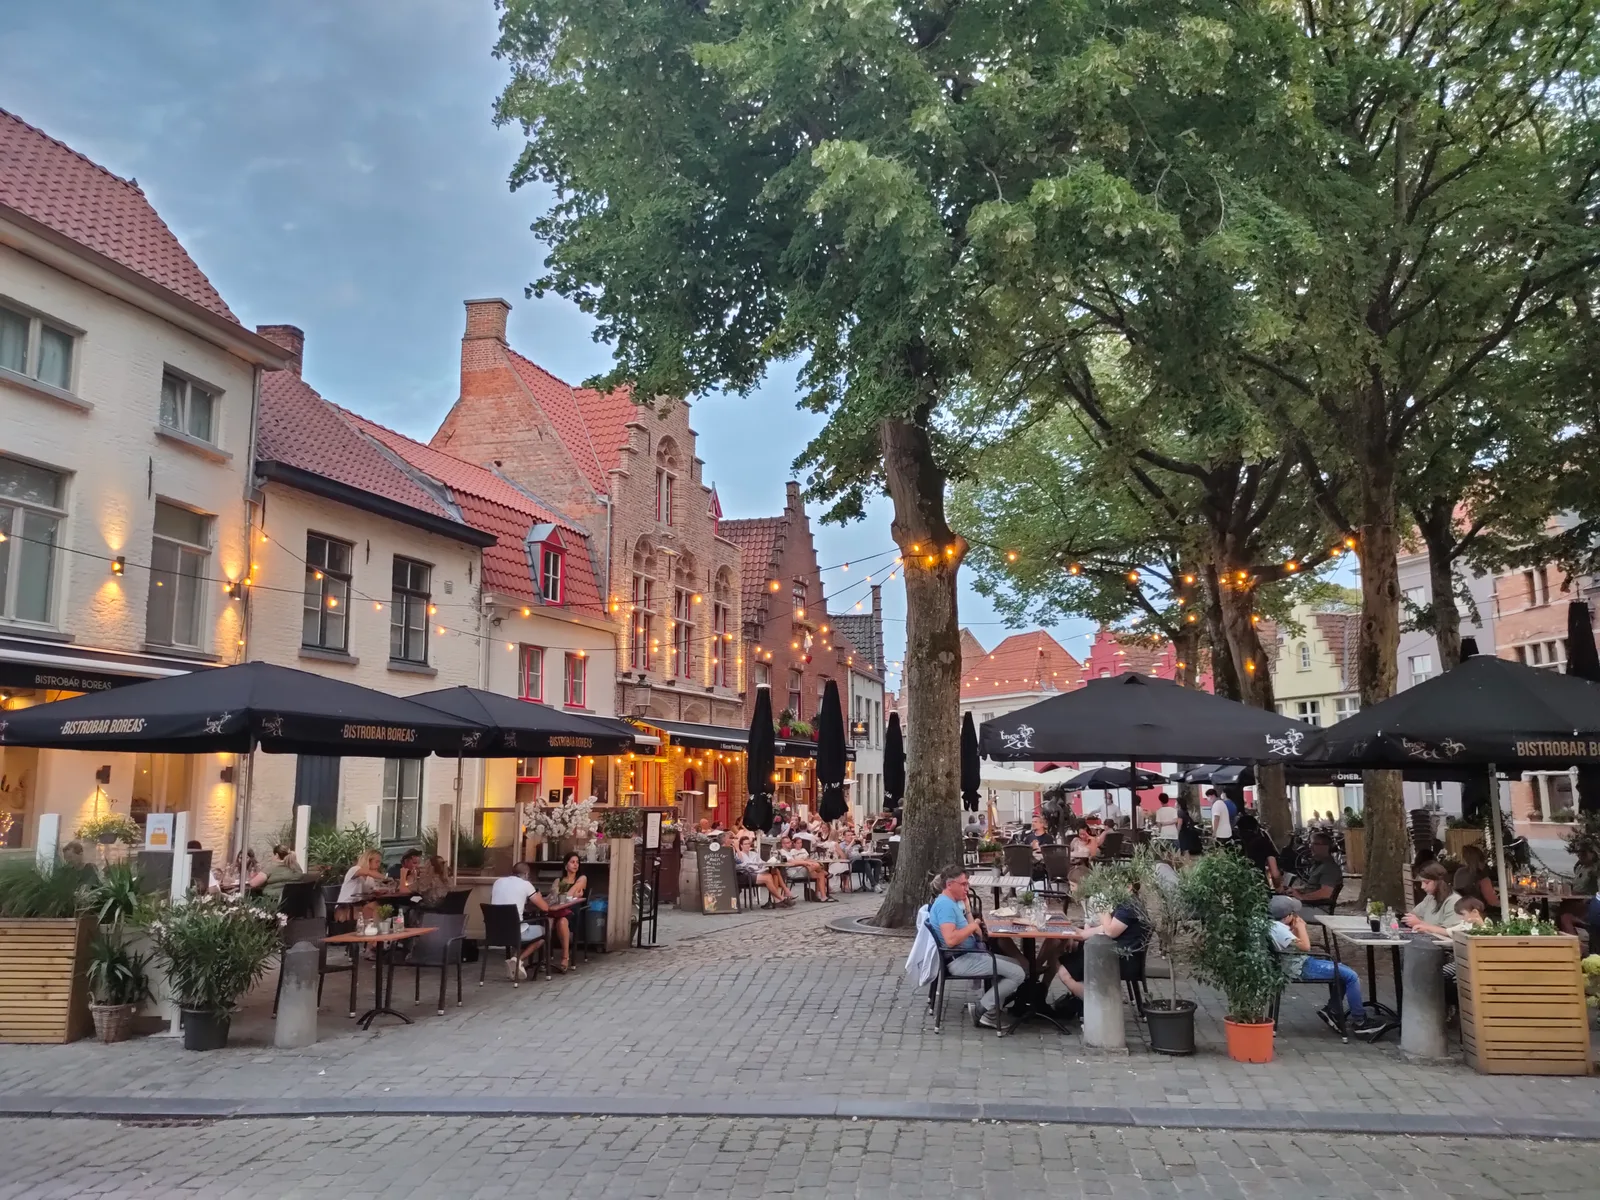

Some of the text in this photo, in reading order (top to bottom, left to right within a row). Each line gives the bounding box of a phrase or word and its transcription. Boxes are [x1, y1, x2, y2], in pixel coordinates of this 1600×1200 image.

[81, 680, 112, 690] BOREAS
[61, 718, 145, 735] BISTROBAR BOREAS
[343, 724, 416, 742] BISTROBAR BOREAS
[1516, 741, 1600, 757] BISTROBAR B
